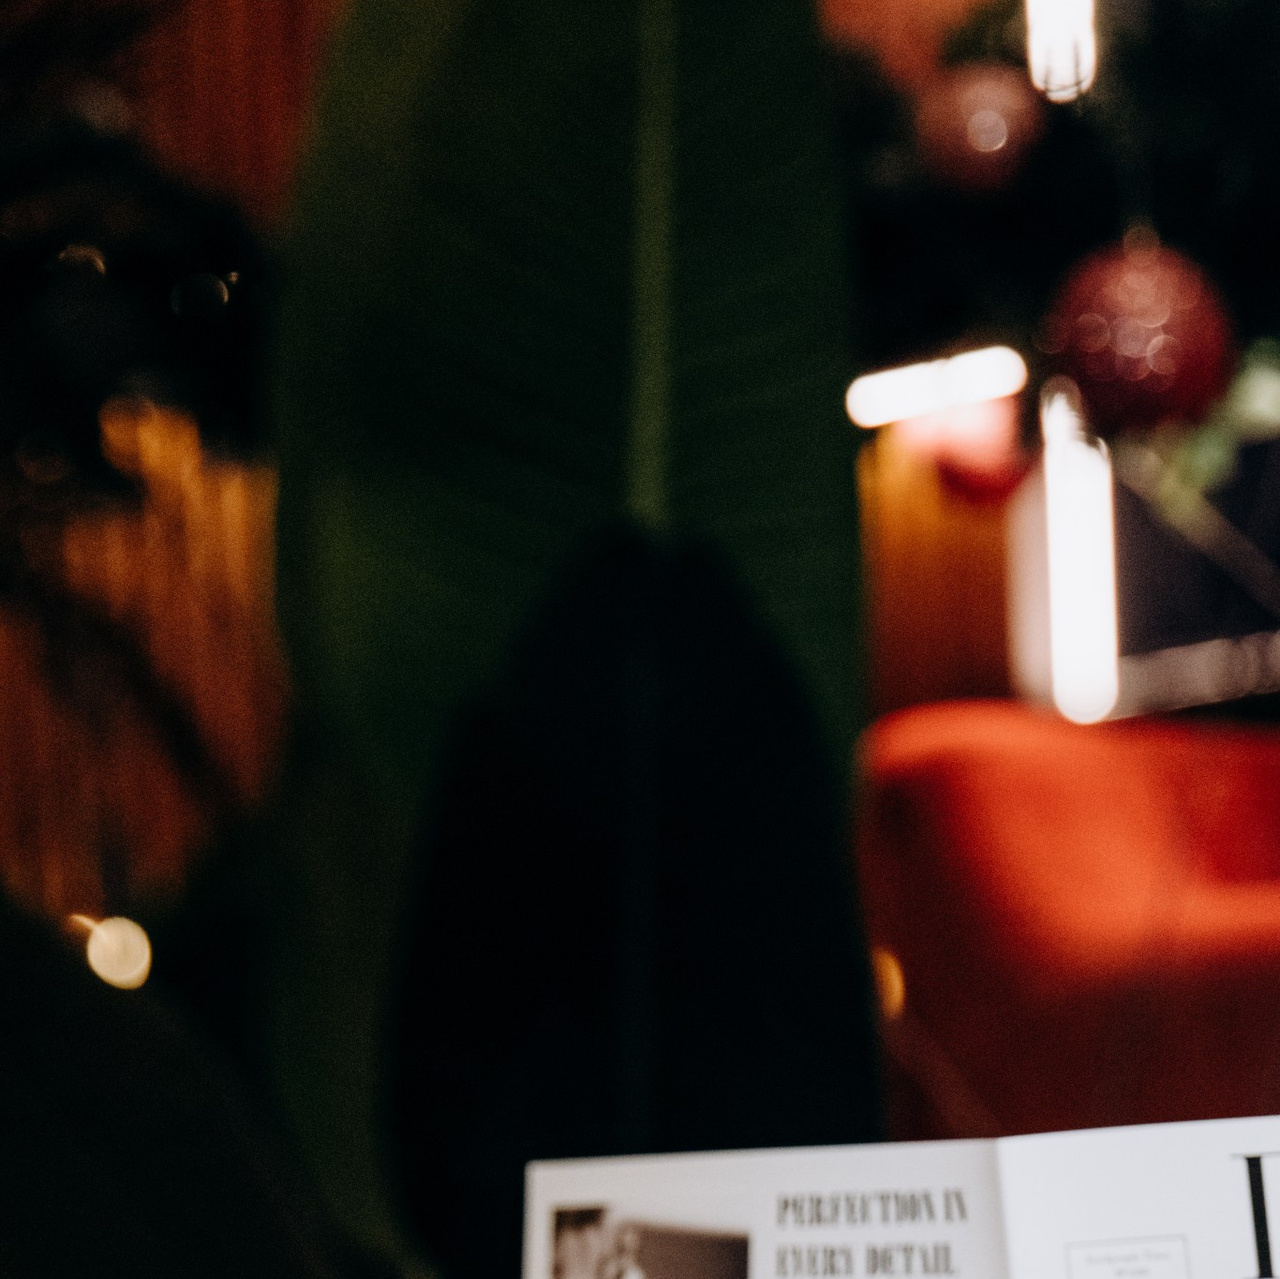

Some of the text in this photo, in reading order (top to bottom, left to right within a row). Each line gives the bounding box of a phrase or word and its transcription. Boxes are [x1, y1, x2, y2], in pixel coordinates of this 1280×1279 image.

[775, 1187, 969, 1228] PERFECTION IN
[775, 1241, 957, 1279] EVERY DETAIL
